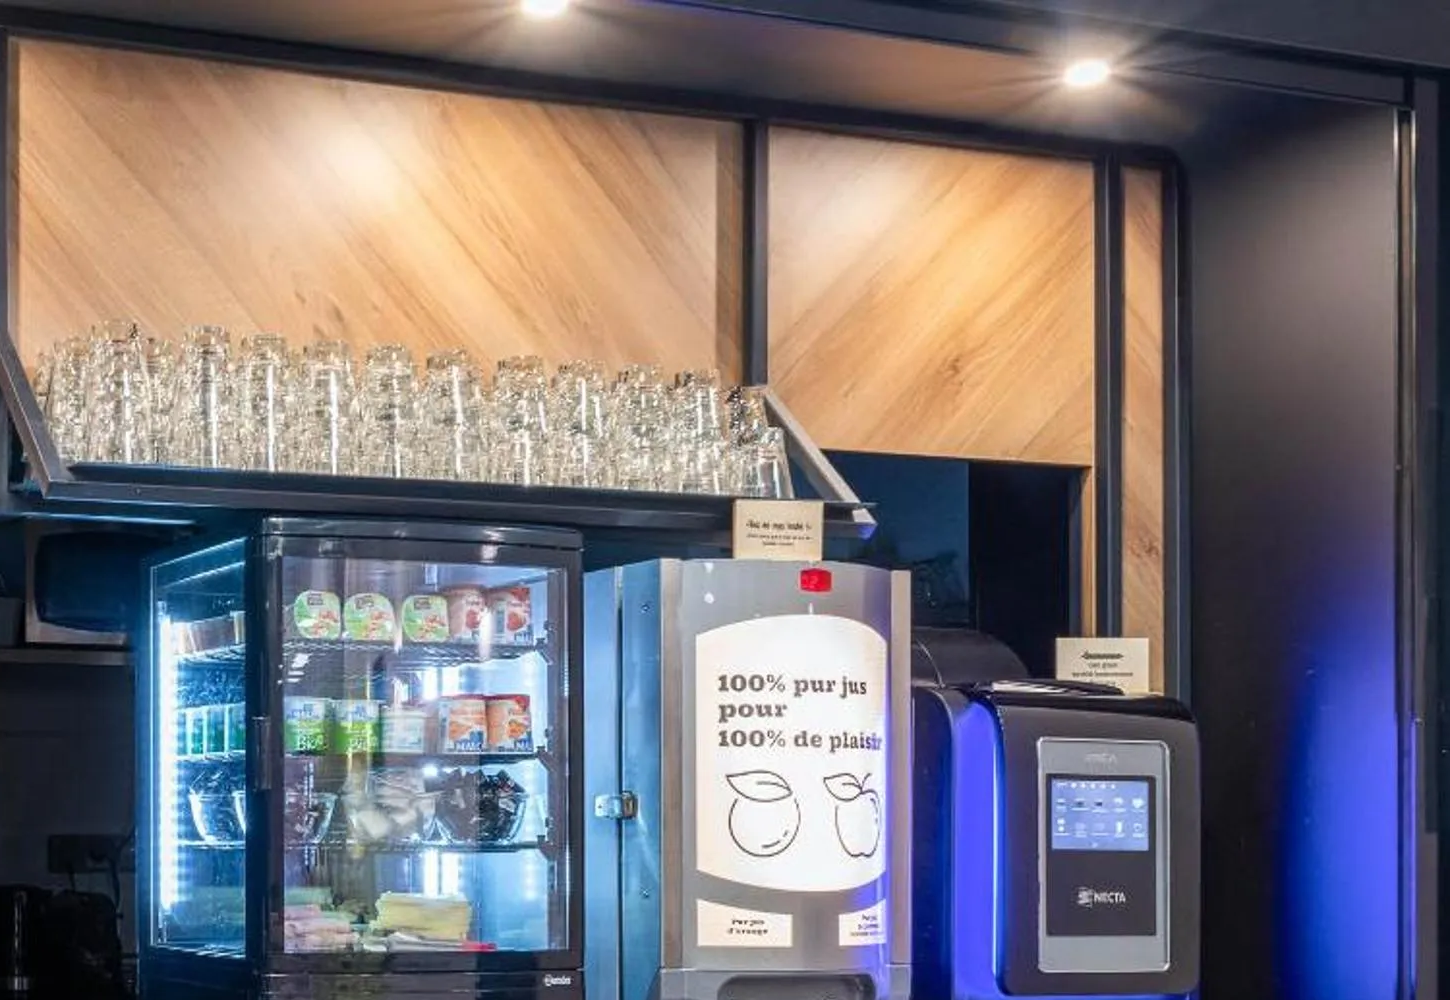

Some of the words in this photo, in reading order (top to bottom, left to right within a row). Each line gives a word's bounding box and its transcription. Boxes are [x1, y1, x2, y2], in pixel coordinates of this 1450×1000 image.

[717, 674, 786, 693] 100%
[793, 678, 836, 698] pur
[839, 675, 867, 699] jus
[717, 703, 788, 724] pour
[717, 729, 786, 748] 100%
[793, 730, 823, 748] de
[829, 731, 882, 754] plaisir
[1093, 892, 1127, 903] NECTA
